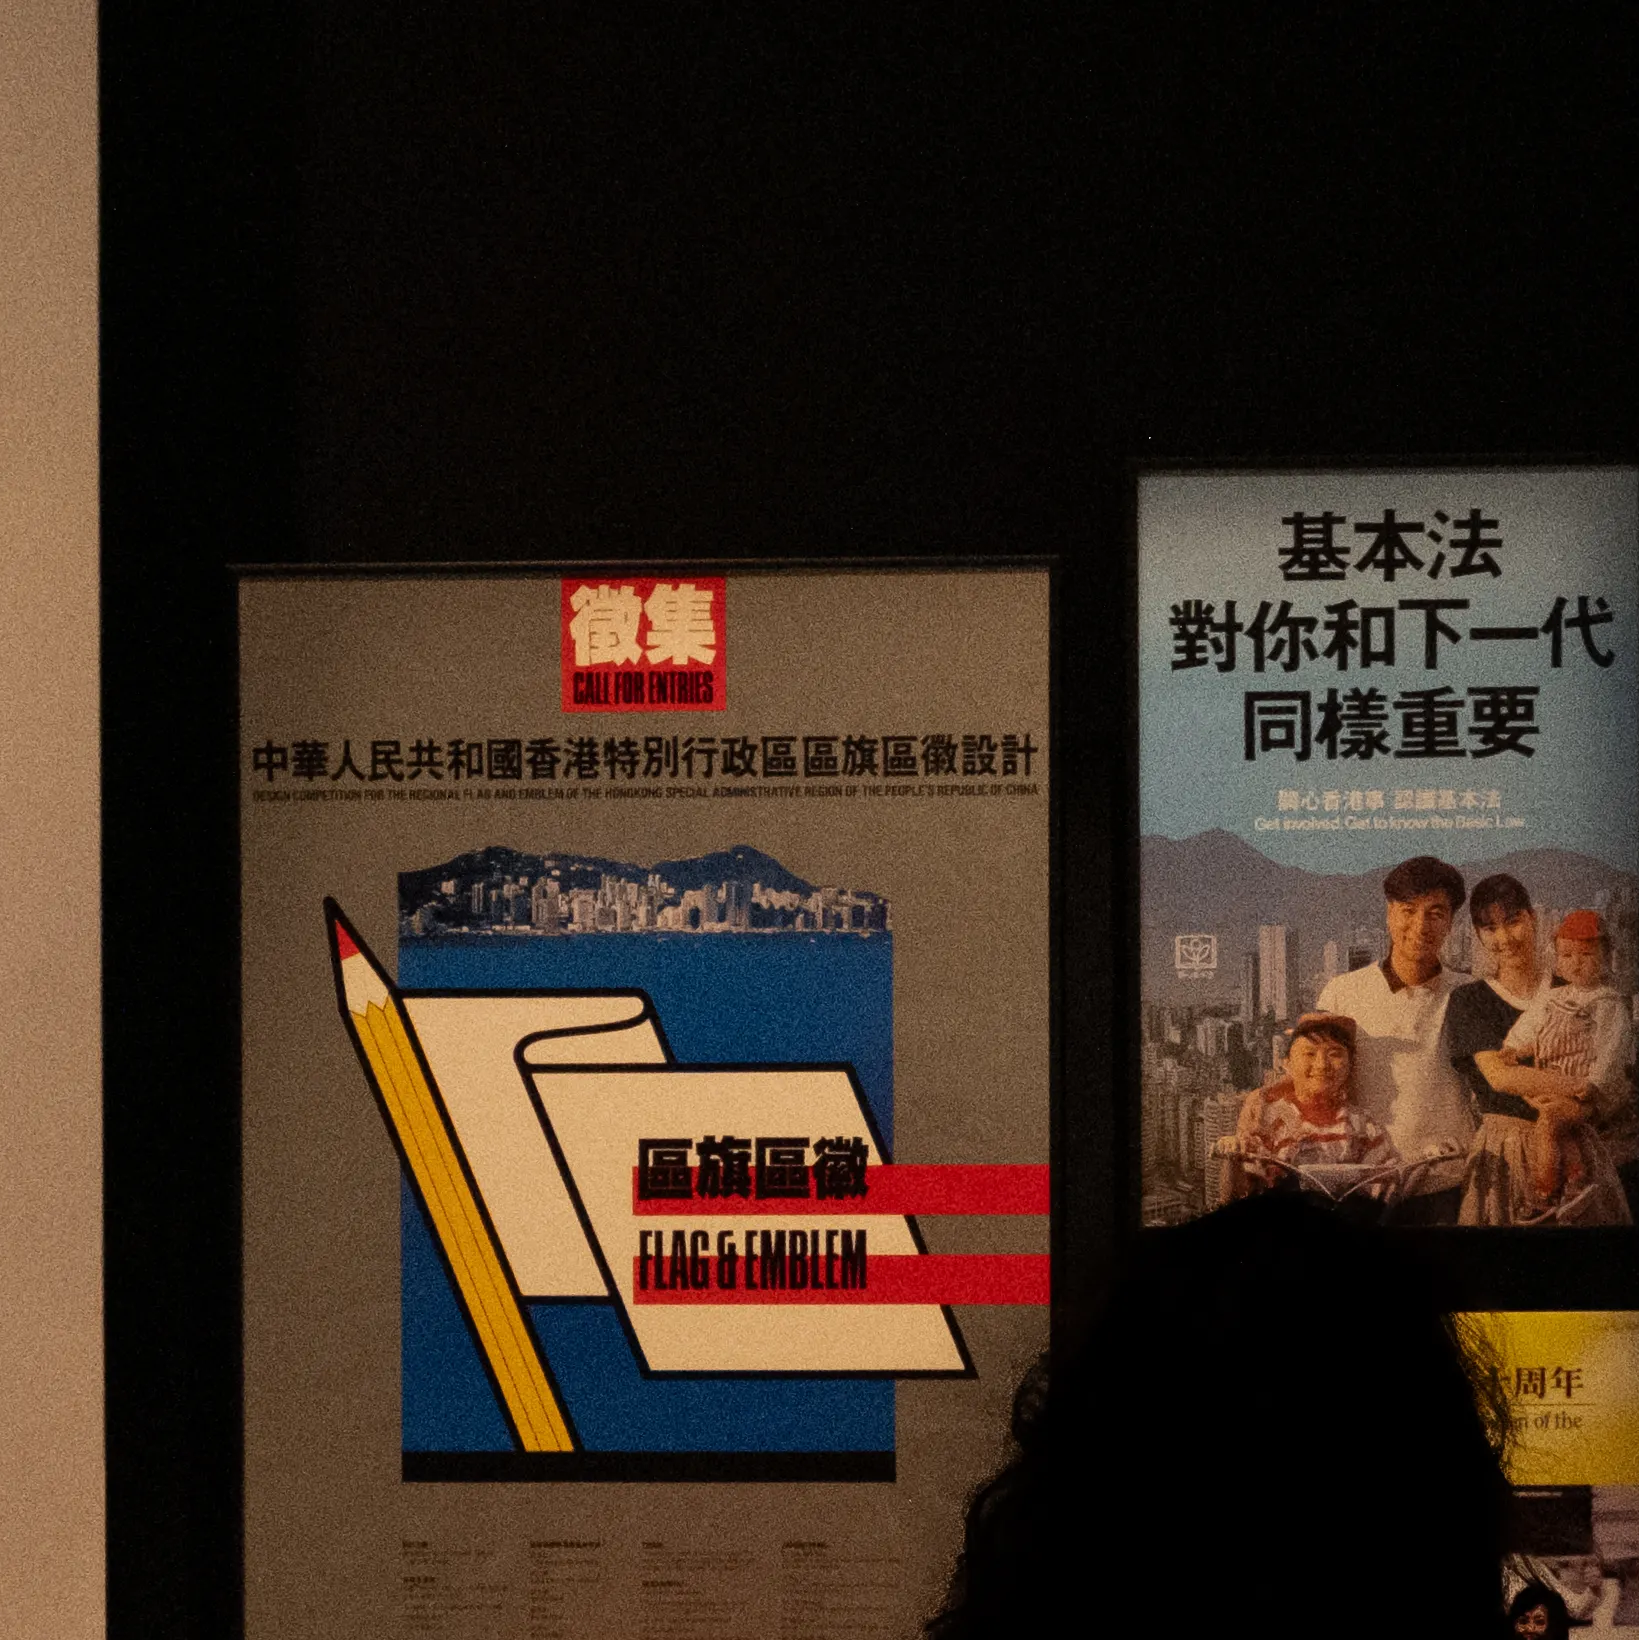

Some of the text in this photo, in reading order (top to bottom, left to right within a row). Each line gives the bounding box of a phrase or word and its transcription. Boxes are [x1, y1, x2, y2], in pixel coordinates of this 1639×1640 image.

[1279, 509, 1503, 581] 基本法
[568, 584, 717, 667] 徵集
[1168, 597, 1615, 672] 對你和下一代
[573, 671, 714, 704] CALL FOR ENTRIES
[1242, 686, 1540, 761] 同樣重要
[252, 734, 1039, 781] 中華人民共和國香港特別行政區區旗區徽設計
[388, 791, 407, 799] THE
[494, 790, 515, 799] AND
[582, 789, 601, 798] THE
[863, 786, 883, 795] THE
[1006, 785, 1038, 794] CHINA
[1393, 790, 1502, 811] 認識基本法
[1389, 816, 1425, 830] know
[1456, 815, 1494, 830] Basic
[637, 1135, 870, 1201] 區旗區徽
[638, 1229, 868, 1292] FLAG & EMBLEM
[1534, 1412, 1551, 1428] of
[1555, 1411, 1583, 1429] the
